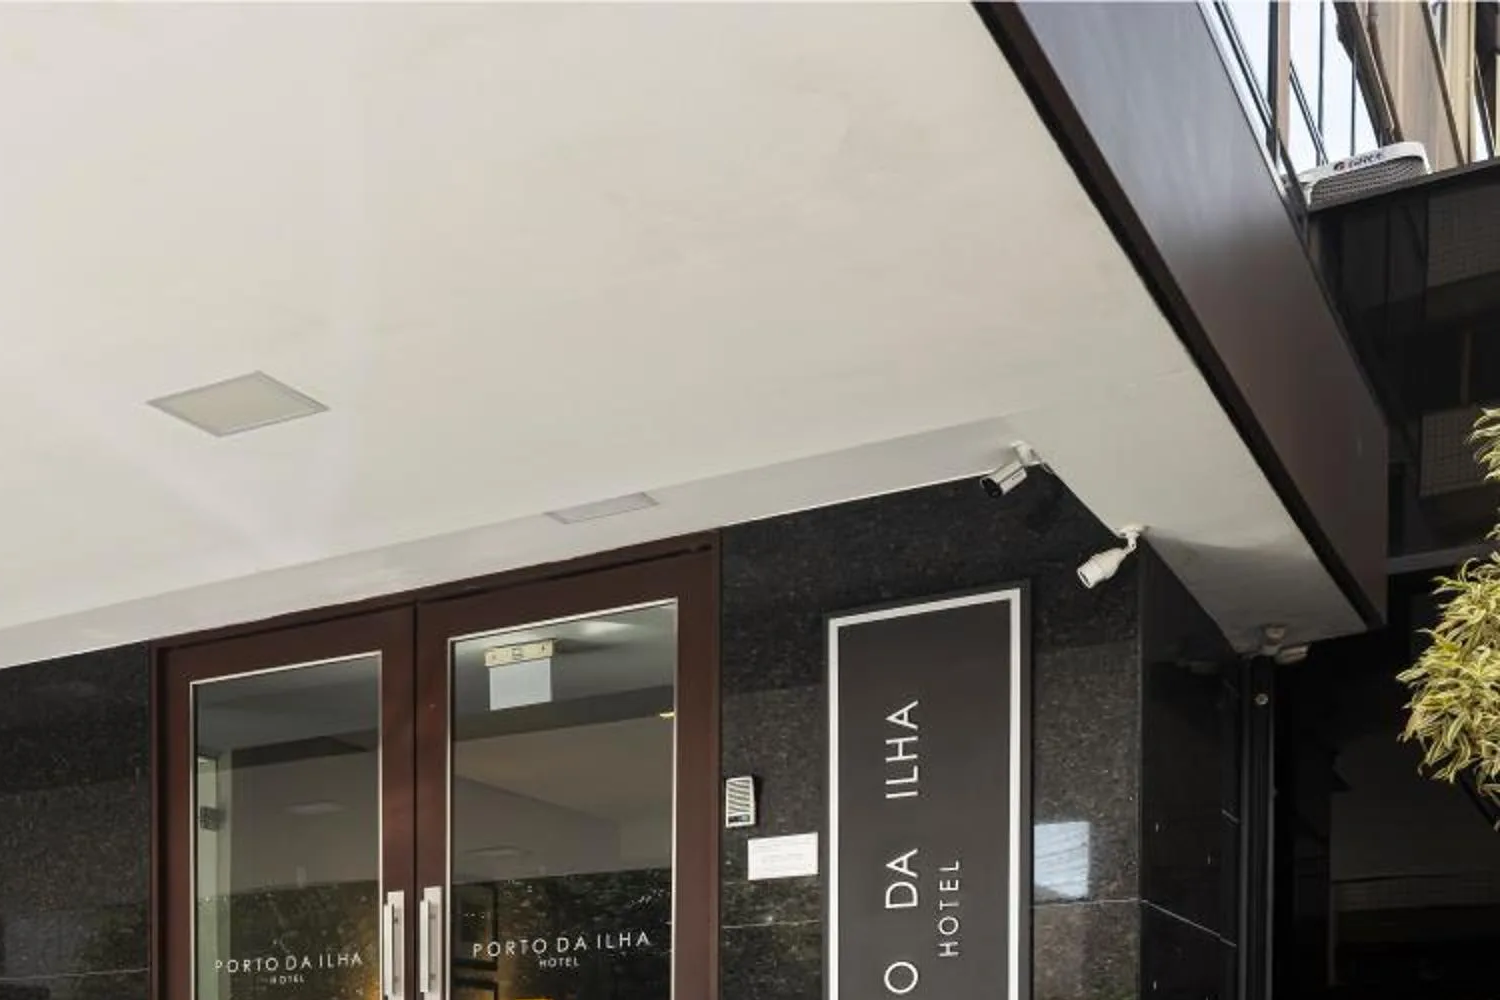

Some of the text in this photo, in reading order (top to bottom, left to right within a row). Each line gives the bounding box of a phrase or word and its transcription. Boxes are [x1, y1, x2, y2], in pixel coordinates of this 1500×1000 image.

[885, 700, 919, 799] ILHA
[885, 848, 918, 909] DA
[938, 860, 961, 957] HOTEL
[214, 951, 363, 973] PORTO DA ILHA
[472, 931, 650, 957] PORTO DA ILHA
[539, 956, 580, 968] HOTEL
